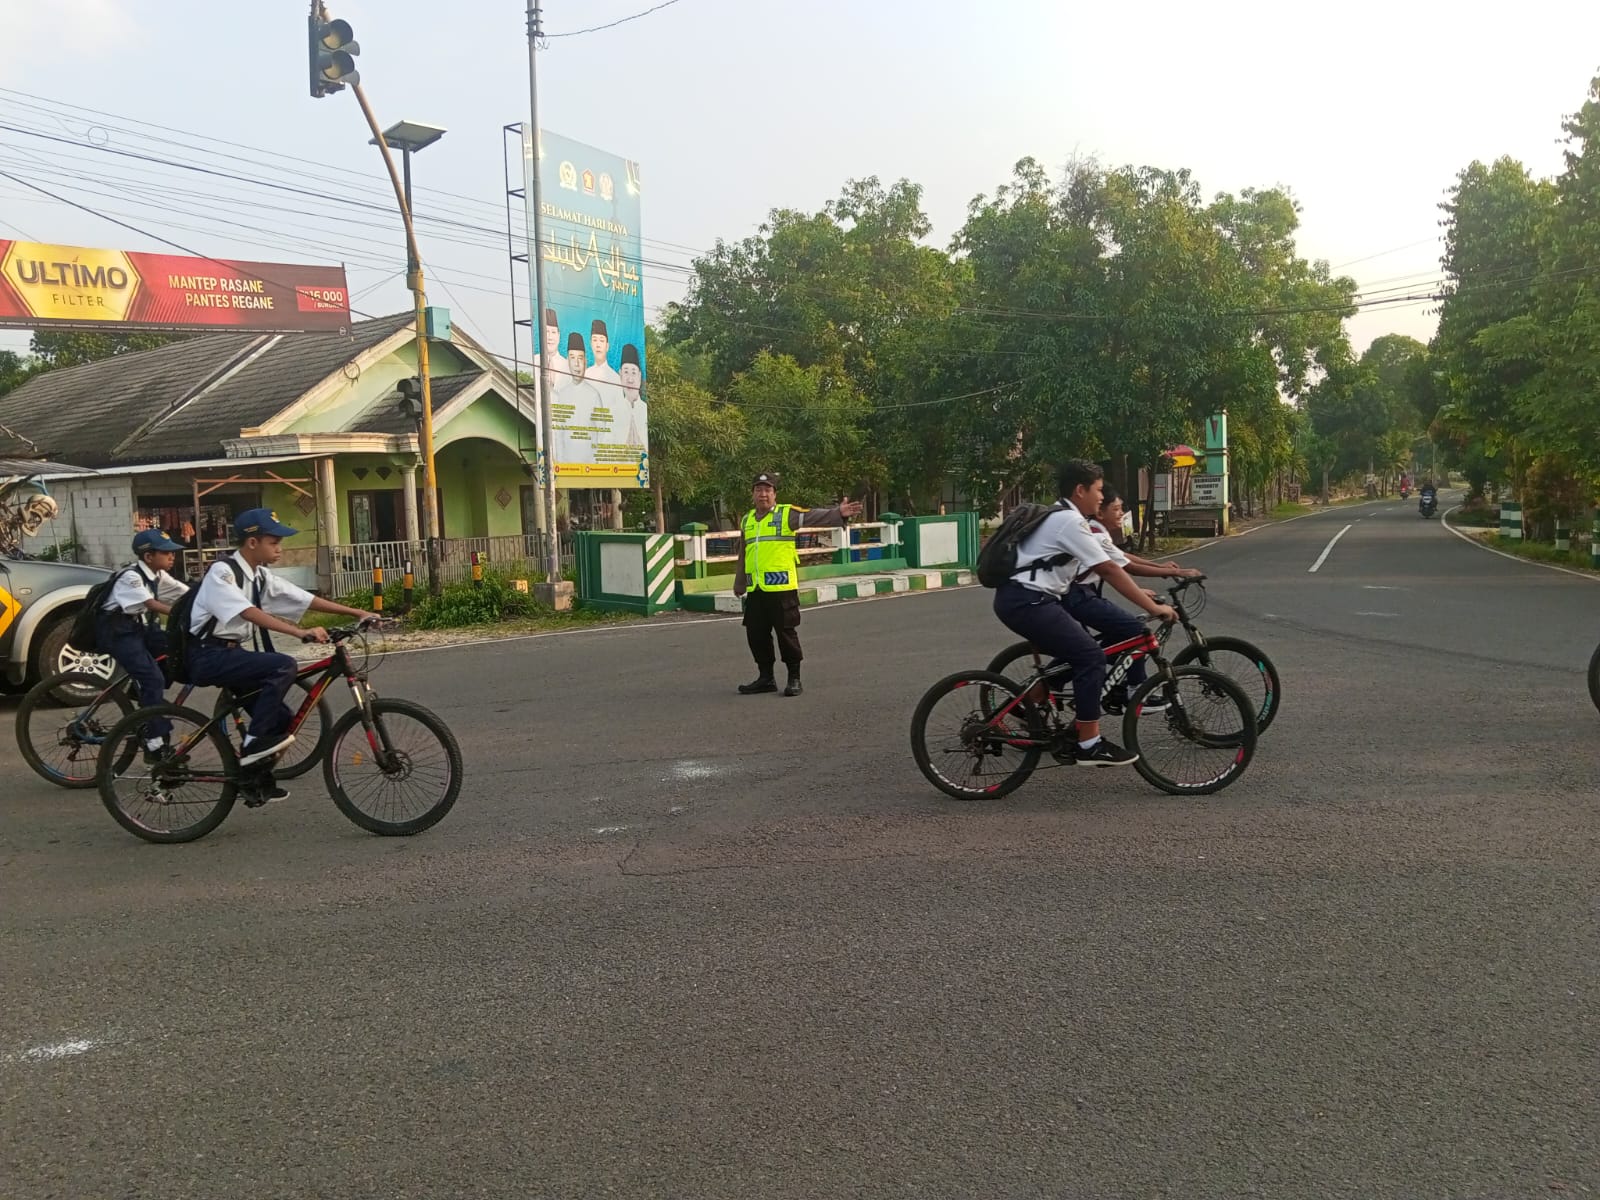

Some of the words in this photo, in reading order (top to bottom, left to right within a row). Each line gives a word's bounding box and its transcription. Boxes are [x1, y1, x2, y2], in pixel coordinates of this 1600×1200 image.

[541, 202, 583, 222] SELAMAT
[584, 215, 606, 230] HARI
[607, 222, 628, 236] RAYA
[168, 275, 217, 291] MANTEP
[220, 278, 265, 293] RASANE
[52, 294, 104, 307] FILTER
[185, 293, 230, 308] PANTES
[232, 296, 274, 310] REGANE
